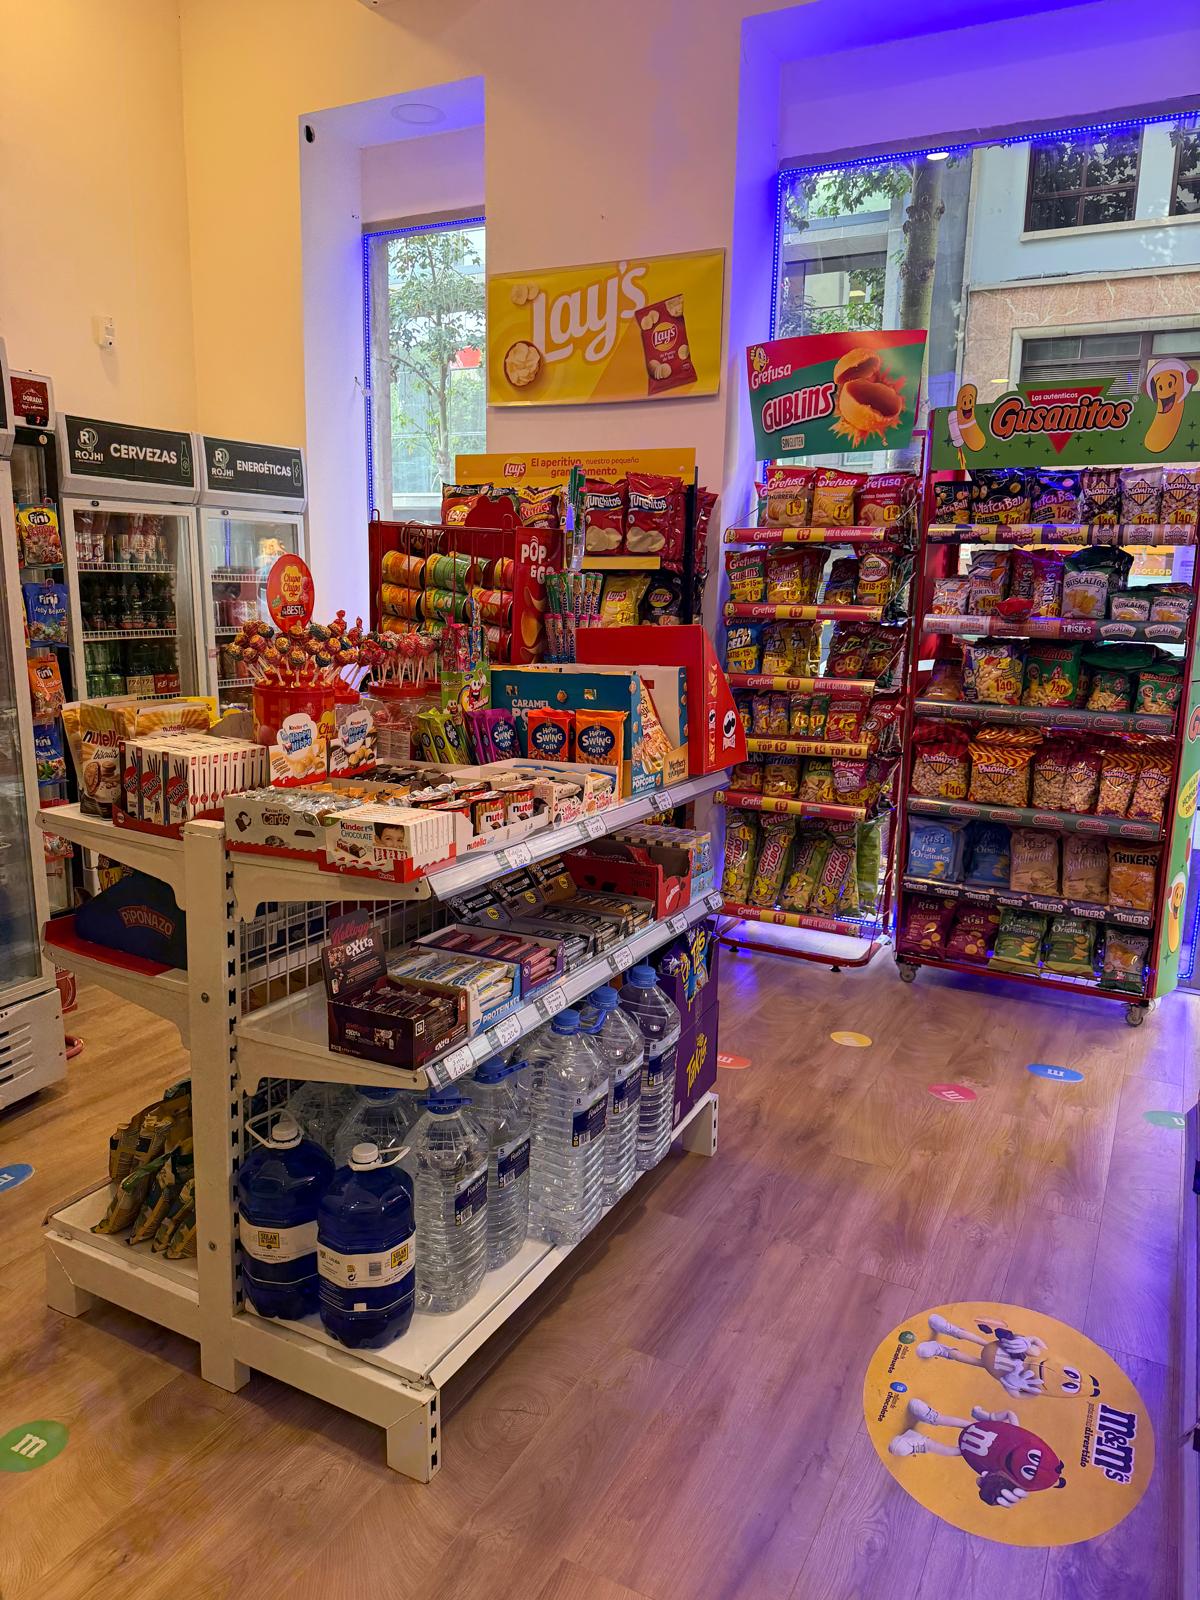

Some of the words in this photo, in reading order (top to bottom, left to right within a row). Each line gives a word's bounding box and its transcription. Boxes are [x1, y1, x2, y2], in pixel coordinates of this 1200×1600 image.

[533, 261, 646, 362] Lay's
[655, 327, 676, 346] Lay's
[751, 363, 791, 389] Grefusa
[990, 397, 1132, 440] Gusanitos
[75, 450, 104, 461] ROJHI
[110, 443, 178, 465] CERVEZAS
[236, 460, 292, 477] ENERGÉTICAS
[531, 458, 540, 467] El
[586, 458, 610, 466] nuestro
[611, 457, 640, 466] pequeño
[211, 467, 234, 477] ROJHI
[504, 462, 526, 478] Lay's
[584, 468, 617, 476] omento
[768, 477, 805, 490] Grefusa
[817, 476, 857, 487] Grefusa
[1085, 488, 1117, 498] PALOMITAS
[1125, 488, 1158, 499] PALOMITAS
[30, 512, 49, 524] Fini
[753, 530, 782, 540] Grefusa
[287, 605, 302, 615] BEST
[752, 607, 776, 615] Grefus
[512, 699, 549, 709] CARAMEL
[536, 732, 563, 743] SWING
[581, 735, 612, 747] SWING
[141, 775, 161, 796] MIKADO
[167, 780, 188, 802] MIKADO
[486, 811, 504, 822] nute
[341, 829, 373, 841] CHOCOLATE
[467, 837, 487, 850] nutella
[767, 842, 782, 873] TUBO
[911, 848, 950, 863] Originales
[1114, 851, 1159, 866] TRIKERS
[825, 849, 841, 885] GREFU
[835, 853, 849, 880] TUBO
[738, 908, 760, 916] Grefus
[1070, 906, 1106, 919] TRIKERS
[1114, 912, 1150, 926] TRIKERS
[346, 937, 374, 957] extra
[878, 1391, 893, 1422] chocolate
[1080, 1426, 1093, 1468] divertido
